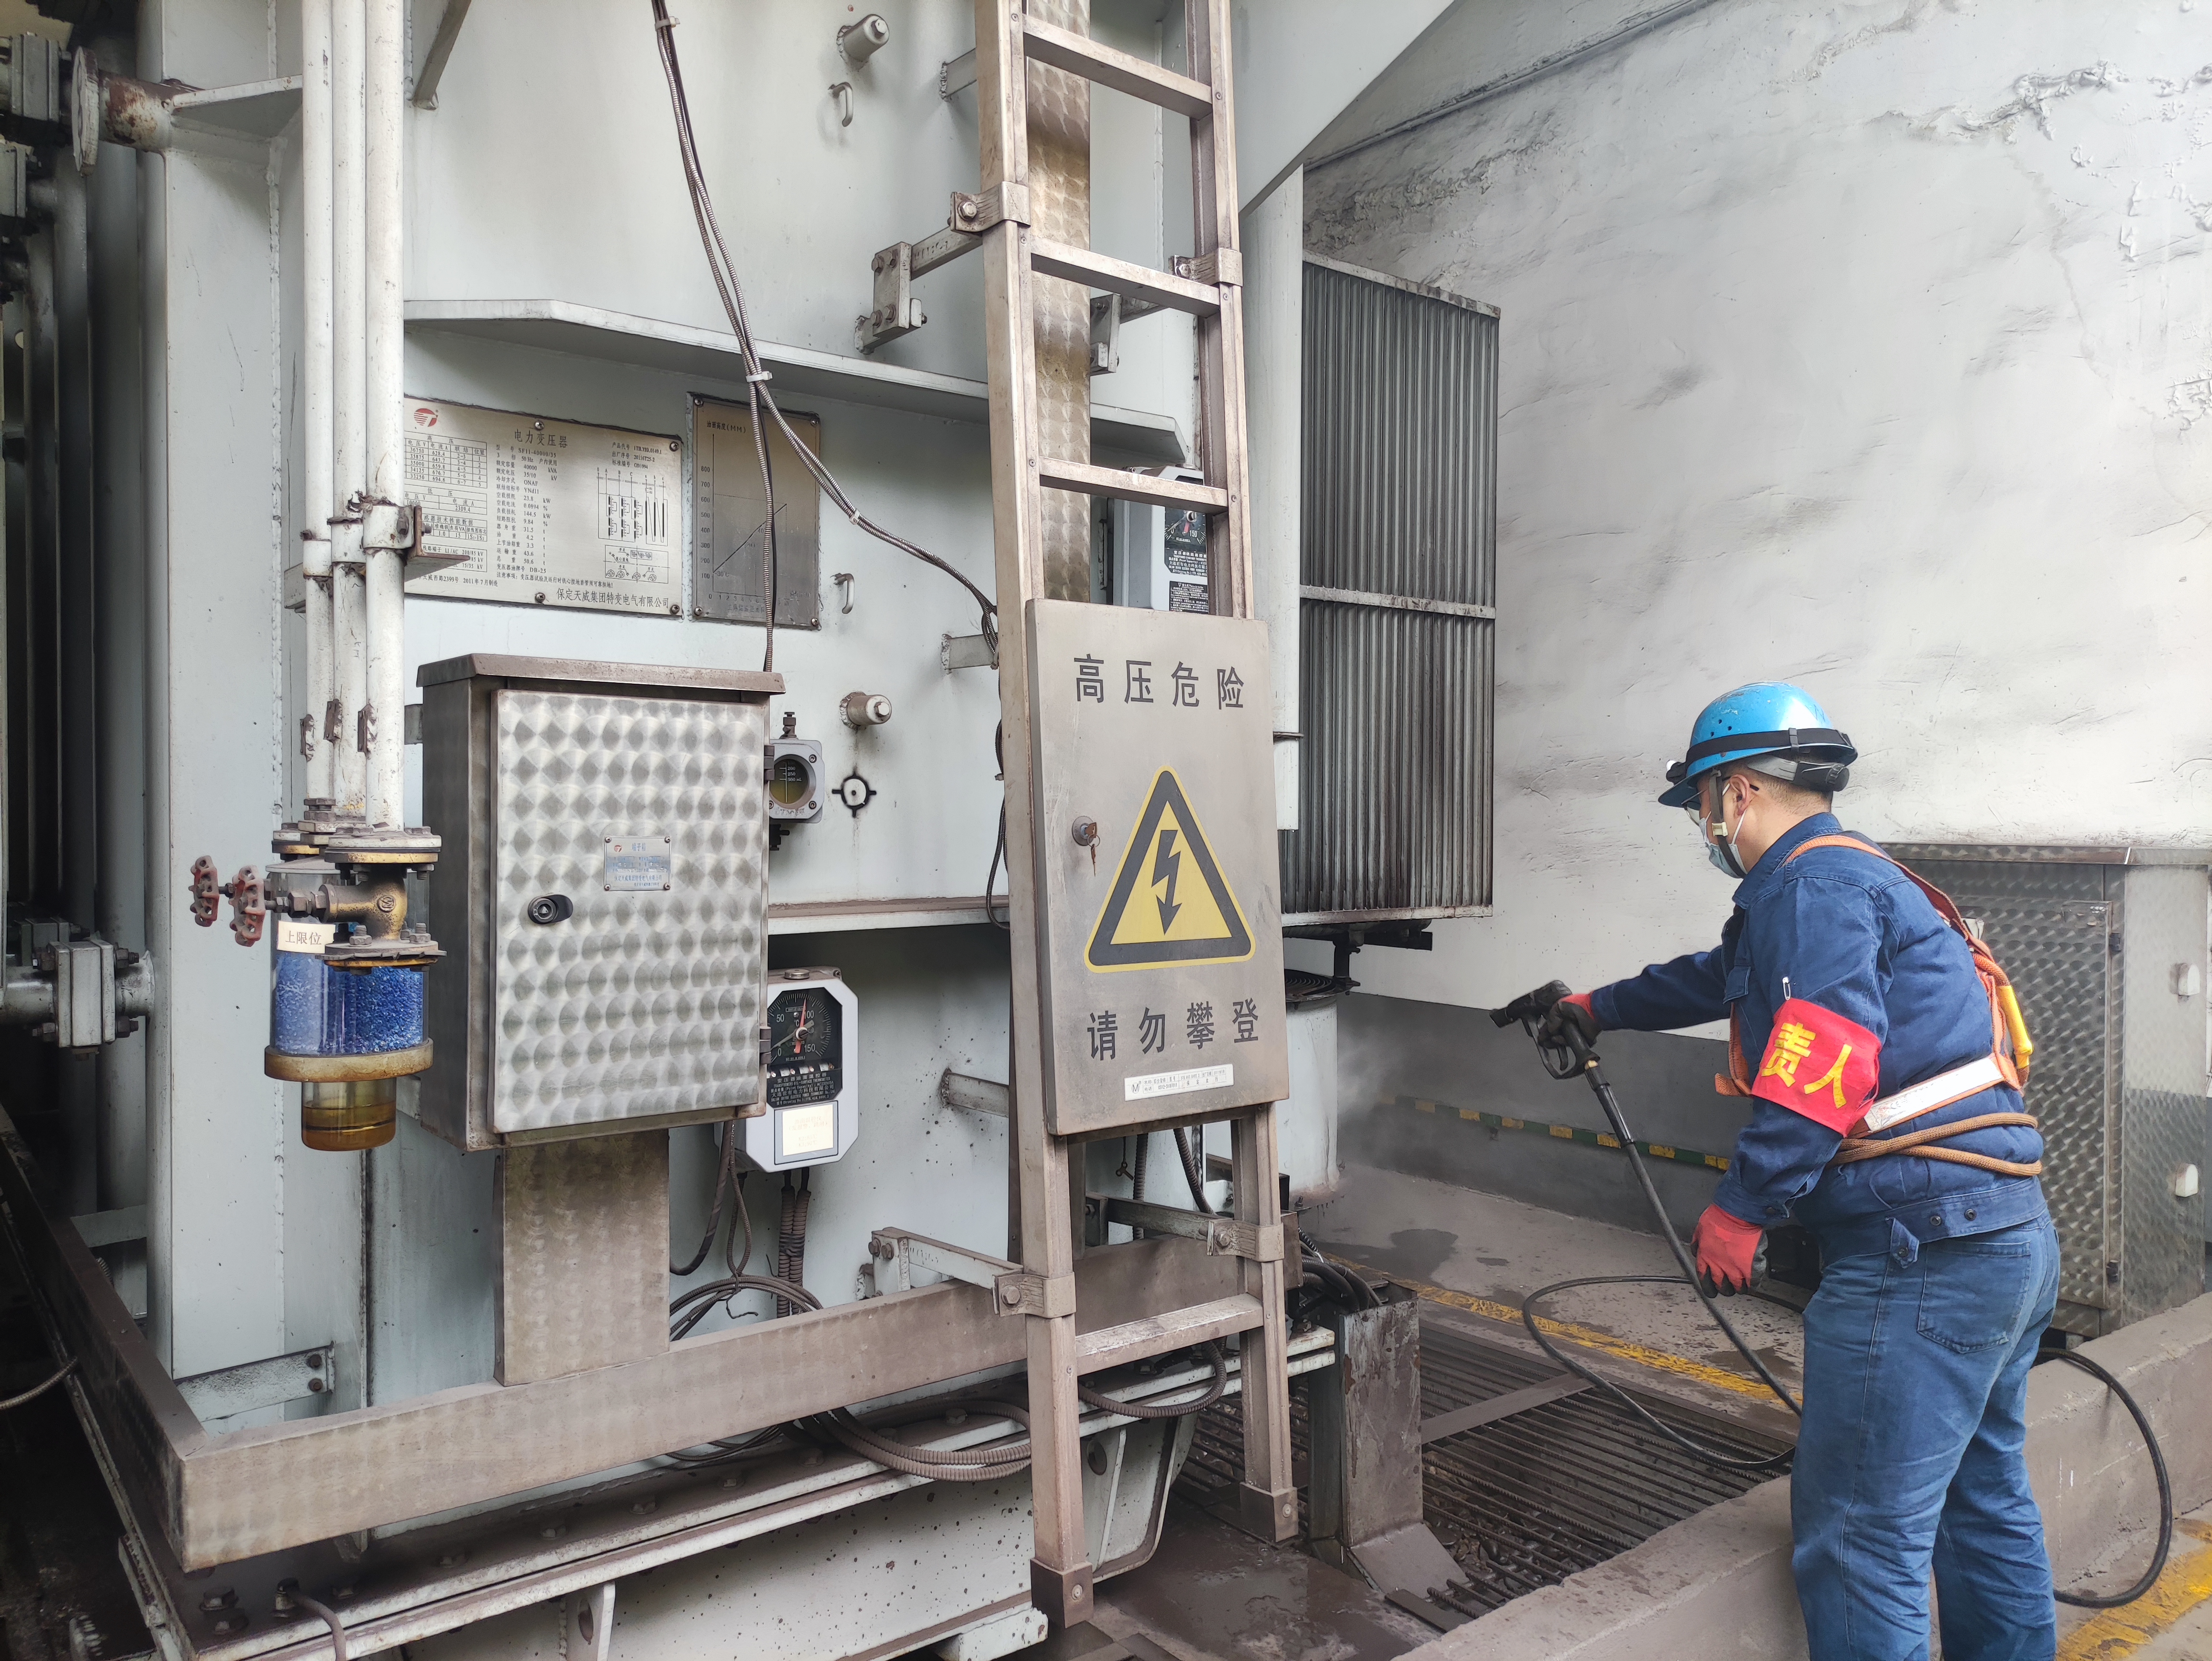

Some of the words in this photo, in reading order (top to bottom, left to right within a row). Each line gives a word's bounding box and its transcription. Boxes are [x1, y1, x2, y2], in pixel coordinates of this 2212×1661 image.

[514, 429, 568, 448] 电力变压器
[612, 442, 630, 450] 产品代号
[519, 448, 556, 457] SF11-40000/35
[612, 451, 630, 459] 出厂序号
[612, 459, 630, 467] 标准编号
[497, 484, 520, 492] 联结组标号
[497, 492, 516, 500] 空载损耗
[497, 499, 516, 508] 空载电流
[497, 508, 516, 516] 负载损耗
[497, 563, 525, 572] 变压器油牌号
[557, 588, 669, 609] 保定天威集团特变电气有限公司
[1074, 653, 1244, 709] 高压危险
[285, 930, 322, 945] 上限位
[776, 1014, 784, 1023] 50
[1087, 997, 1259, 1061] 请勿攀登
[778, 1048, 782, 1056] 0
[805, 1044, 815, 1052] 150
